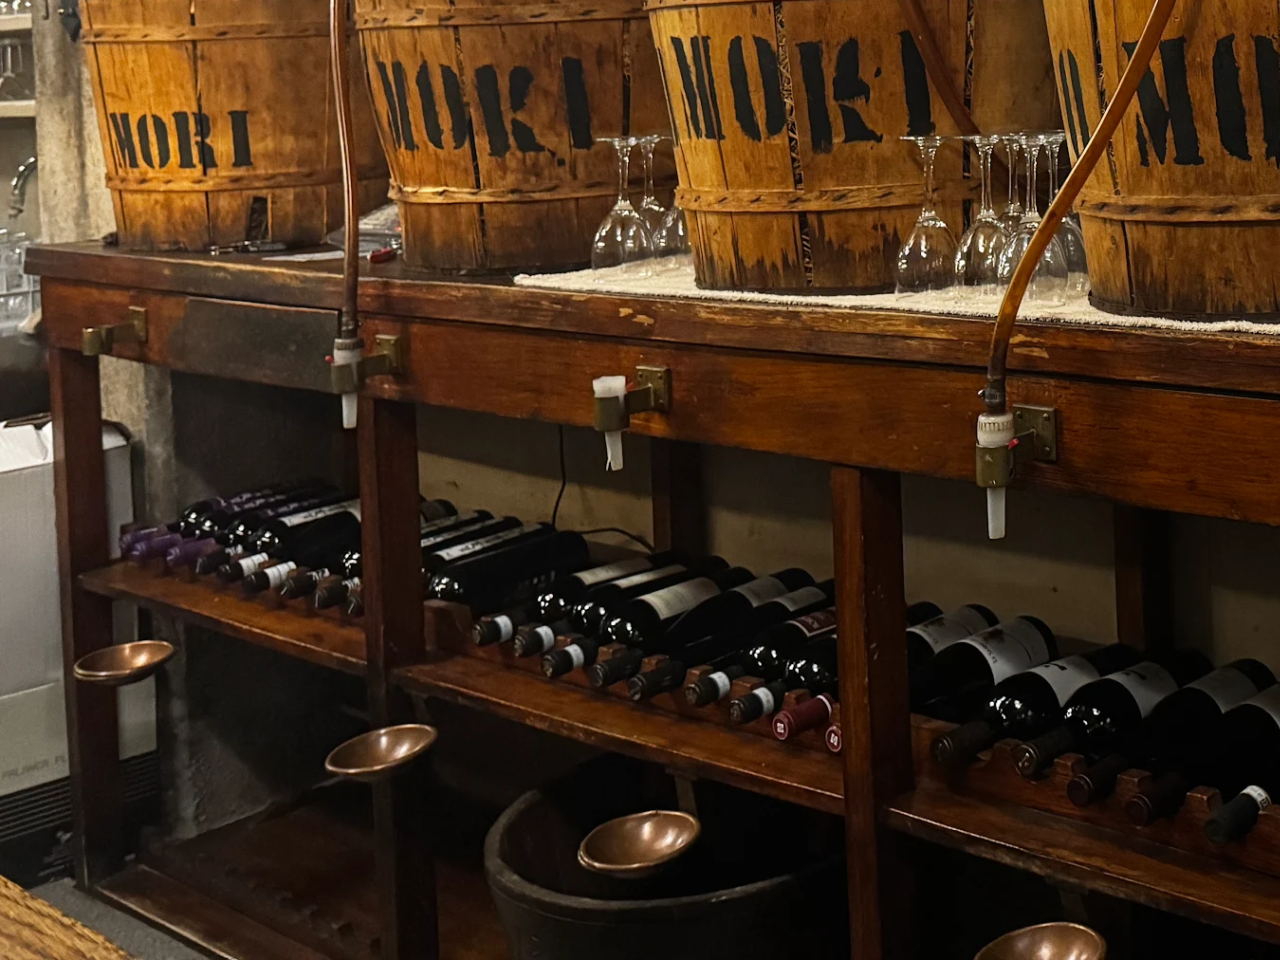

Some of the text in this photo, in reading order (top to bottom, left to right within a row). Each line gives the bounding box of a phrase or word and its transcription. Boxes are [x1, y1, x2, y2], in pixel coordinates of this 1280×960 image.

[109, 110, 255, 170] MORI
[374, 56, 594, 158] MORI
[669, 29, 938, 155] MORI
